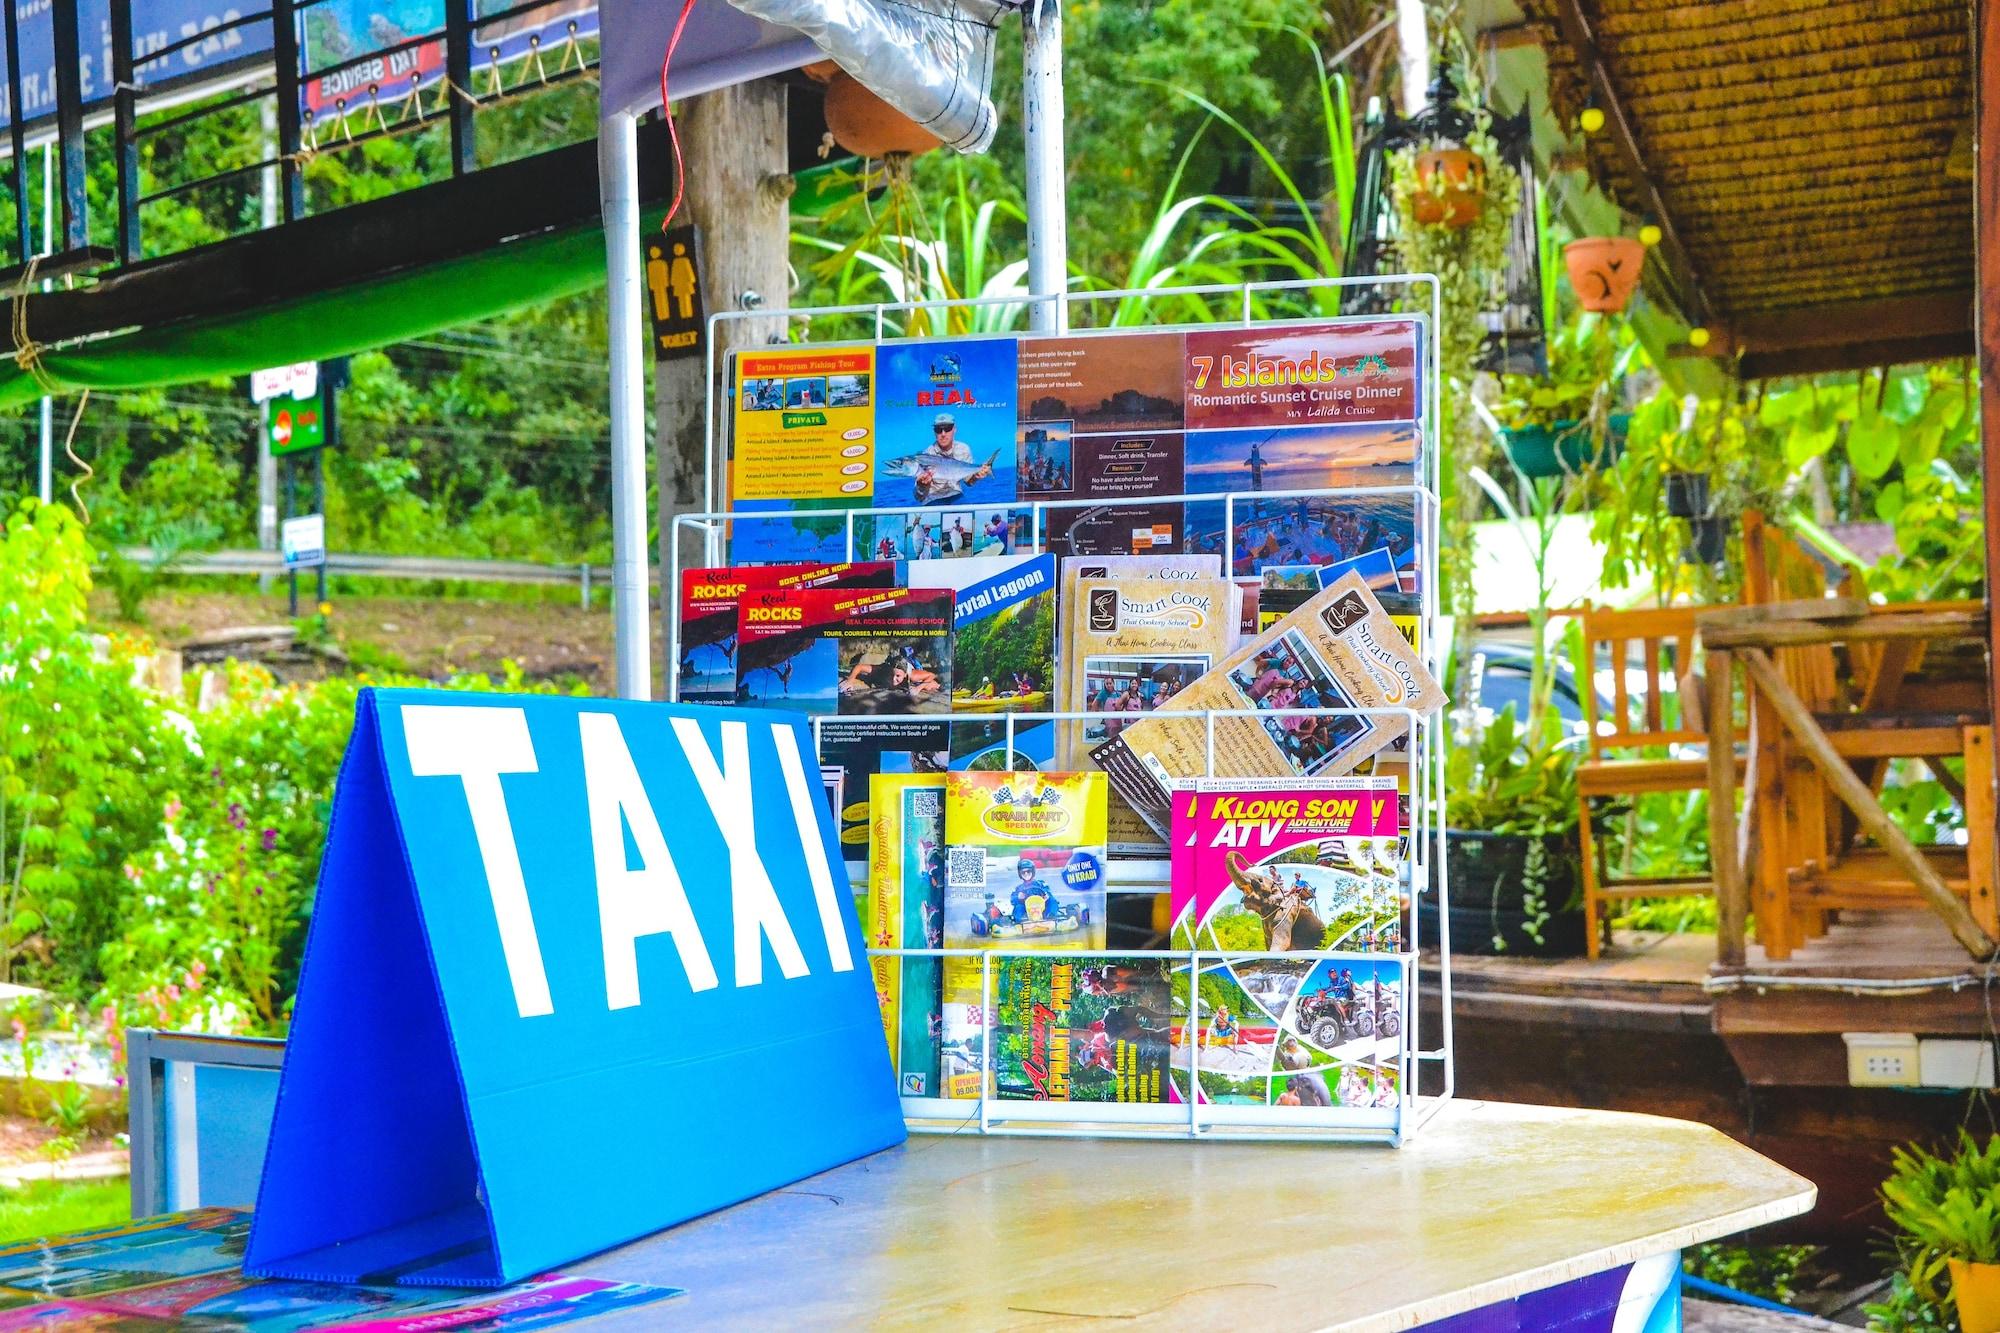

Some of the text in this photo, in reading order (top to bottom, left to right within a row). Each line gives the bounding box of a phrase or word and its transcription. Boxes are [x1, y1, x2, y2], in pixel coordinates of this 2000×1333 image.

[757, 360, 856, 372] Extra Program Fishing Tour
[1192, 350, 1337, 389] 7 Islands
[918, 390, 977, 407] REAL
[1194, 385, 1403, 407] Romantic Sunset Cruise Dinner
[788, 416, 820, 424] PRIVATE
[1307, 406, 1340, 417] Lalida
[1345, 406, 1376, 416] Cruise
[707, 569, 732, 583] Real
[778, 576, 800, 586] BOOK
[802, 568, 830, 580] ONLINE
[832, 562, 852, 574] NOW!
[690, 584, 747, 599] ROCKS
[991, 569, 1044, 602] Lagoon
[761, 591, 786, 606] Real
[834, 588, 908, 610] BOOK ONLINE NOW!
[1122, 592, 1210, 614] Smart Cook
[746, 607, 802, 621] ROCKS
[1122, 618, 1138, 626] Thai
[1138, 619, 1166, 627] Cookery
[1106, 636, 1199, 650] A Thai Home Cooking Class
[1346, 635, 1390, 692] Thai Cookery School
[1358, 622, 1422, 700] Smart Cook
[1332, 652, 1347, 672] Home
[1344, 671, 1366, 700] Cooking
[991, 810, 1064, 822] KRABI KART
[1211, 796, 1358, 820] KLONG SON
[1210, 818, 1286, 848] ATV
[1287, 818, 1352, 827] ADVENTURE
[874, 815, 892, 873] Kayaking
[400, 703, 855, 1019] TAXI
[1068, 861, 1092, 872] ONLY ONE
[1067, 870, 1097, 884] IN KRABI
[1050, 964, 1073, 1010] PARK
[1116, 1040, 1126, 1075] Trekking
[1128, 1044, 1138, 1075] Bathing
[955, 1078, 970, 1088] OPEN
[1151, 1070, 1160, 1096] Riding
